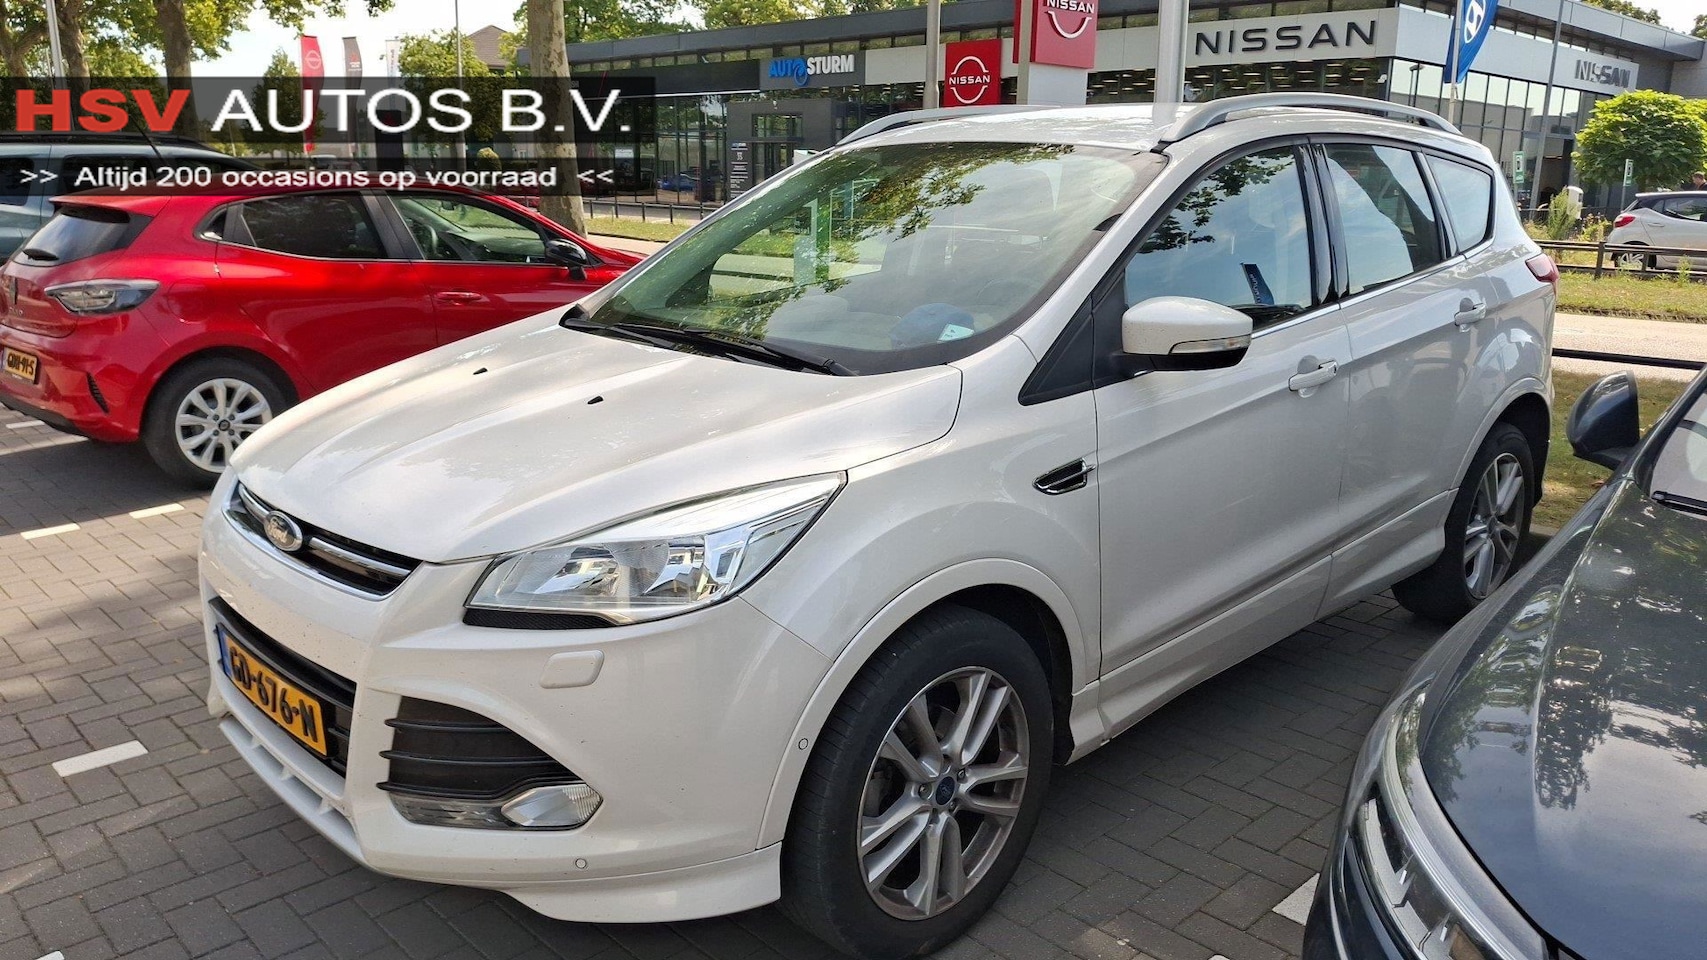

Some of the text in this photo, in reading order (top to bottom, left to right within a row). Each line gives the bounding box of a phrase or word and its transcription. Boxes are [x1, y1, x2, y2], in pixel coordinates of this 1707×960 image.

[1046, 0, 1095, 14] NISSAN
[1195, 20, 1376, 56] NISSAN
[948, 74, 991, 85] NISSAN
[1575, 60, 1631, 88] NISSAN
[230, 646, 318, 743] GD-676-N
